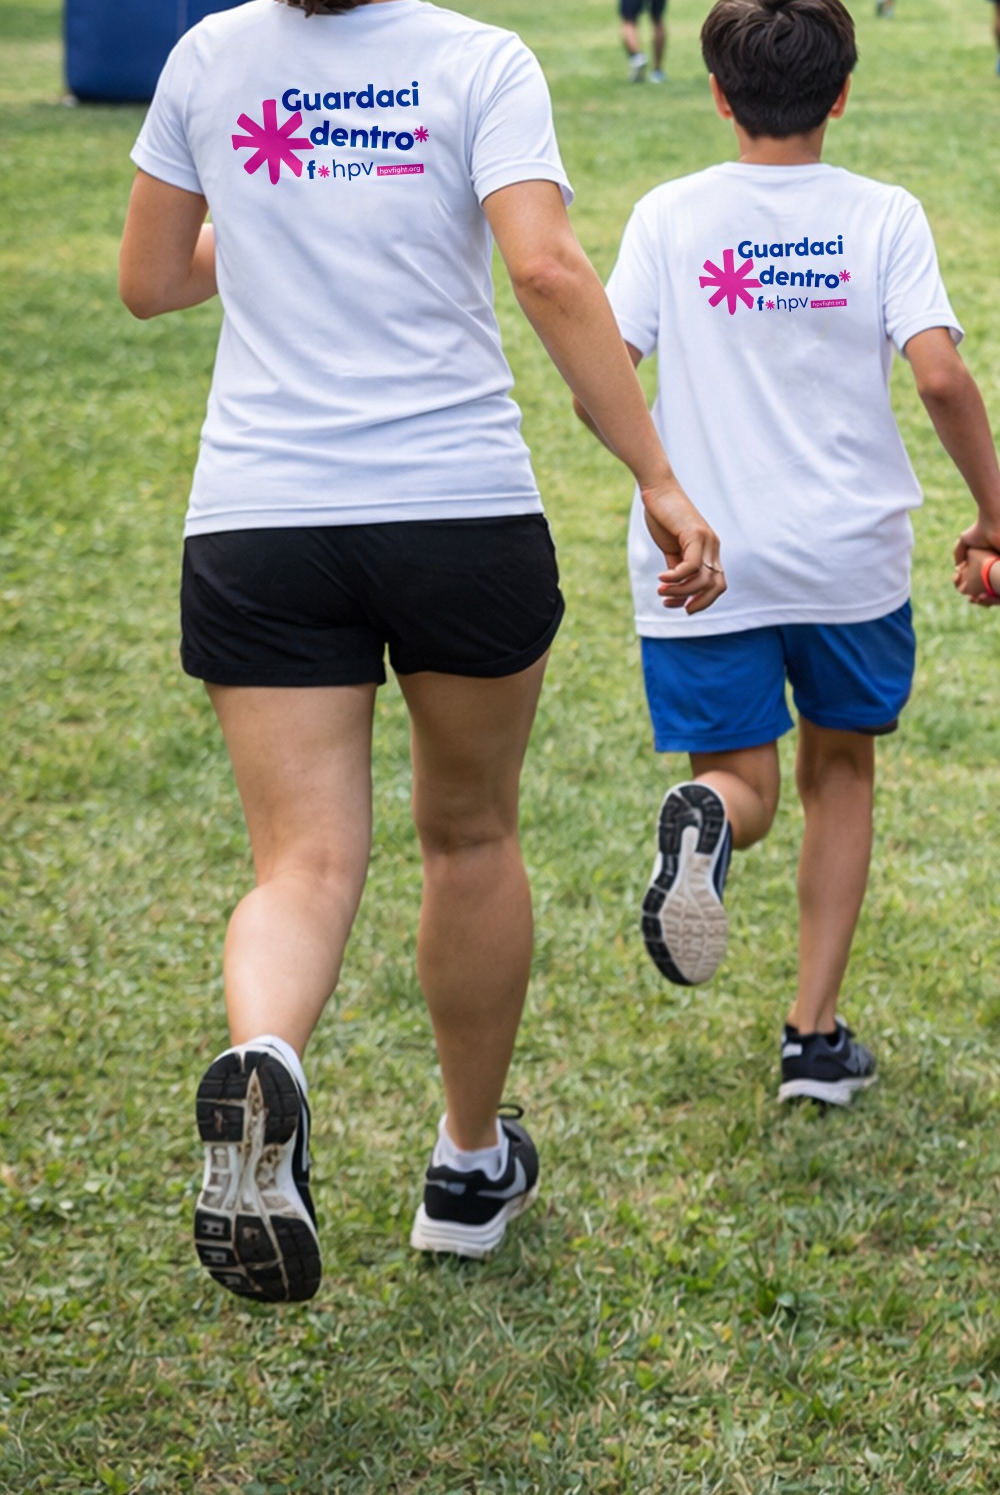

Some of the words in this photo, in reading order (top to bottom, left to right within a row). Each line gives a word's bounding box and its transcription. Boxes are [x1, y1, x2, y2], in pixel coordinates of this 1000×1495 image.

[281, 80, 419, 113] Guardaci
[379, 165, 421, 175] hpvfight.org
[737, 234, 844, 260] Guardaci
